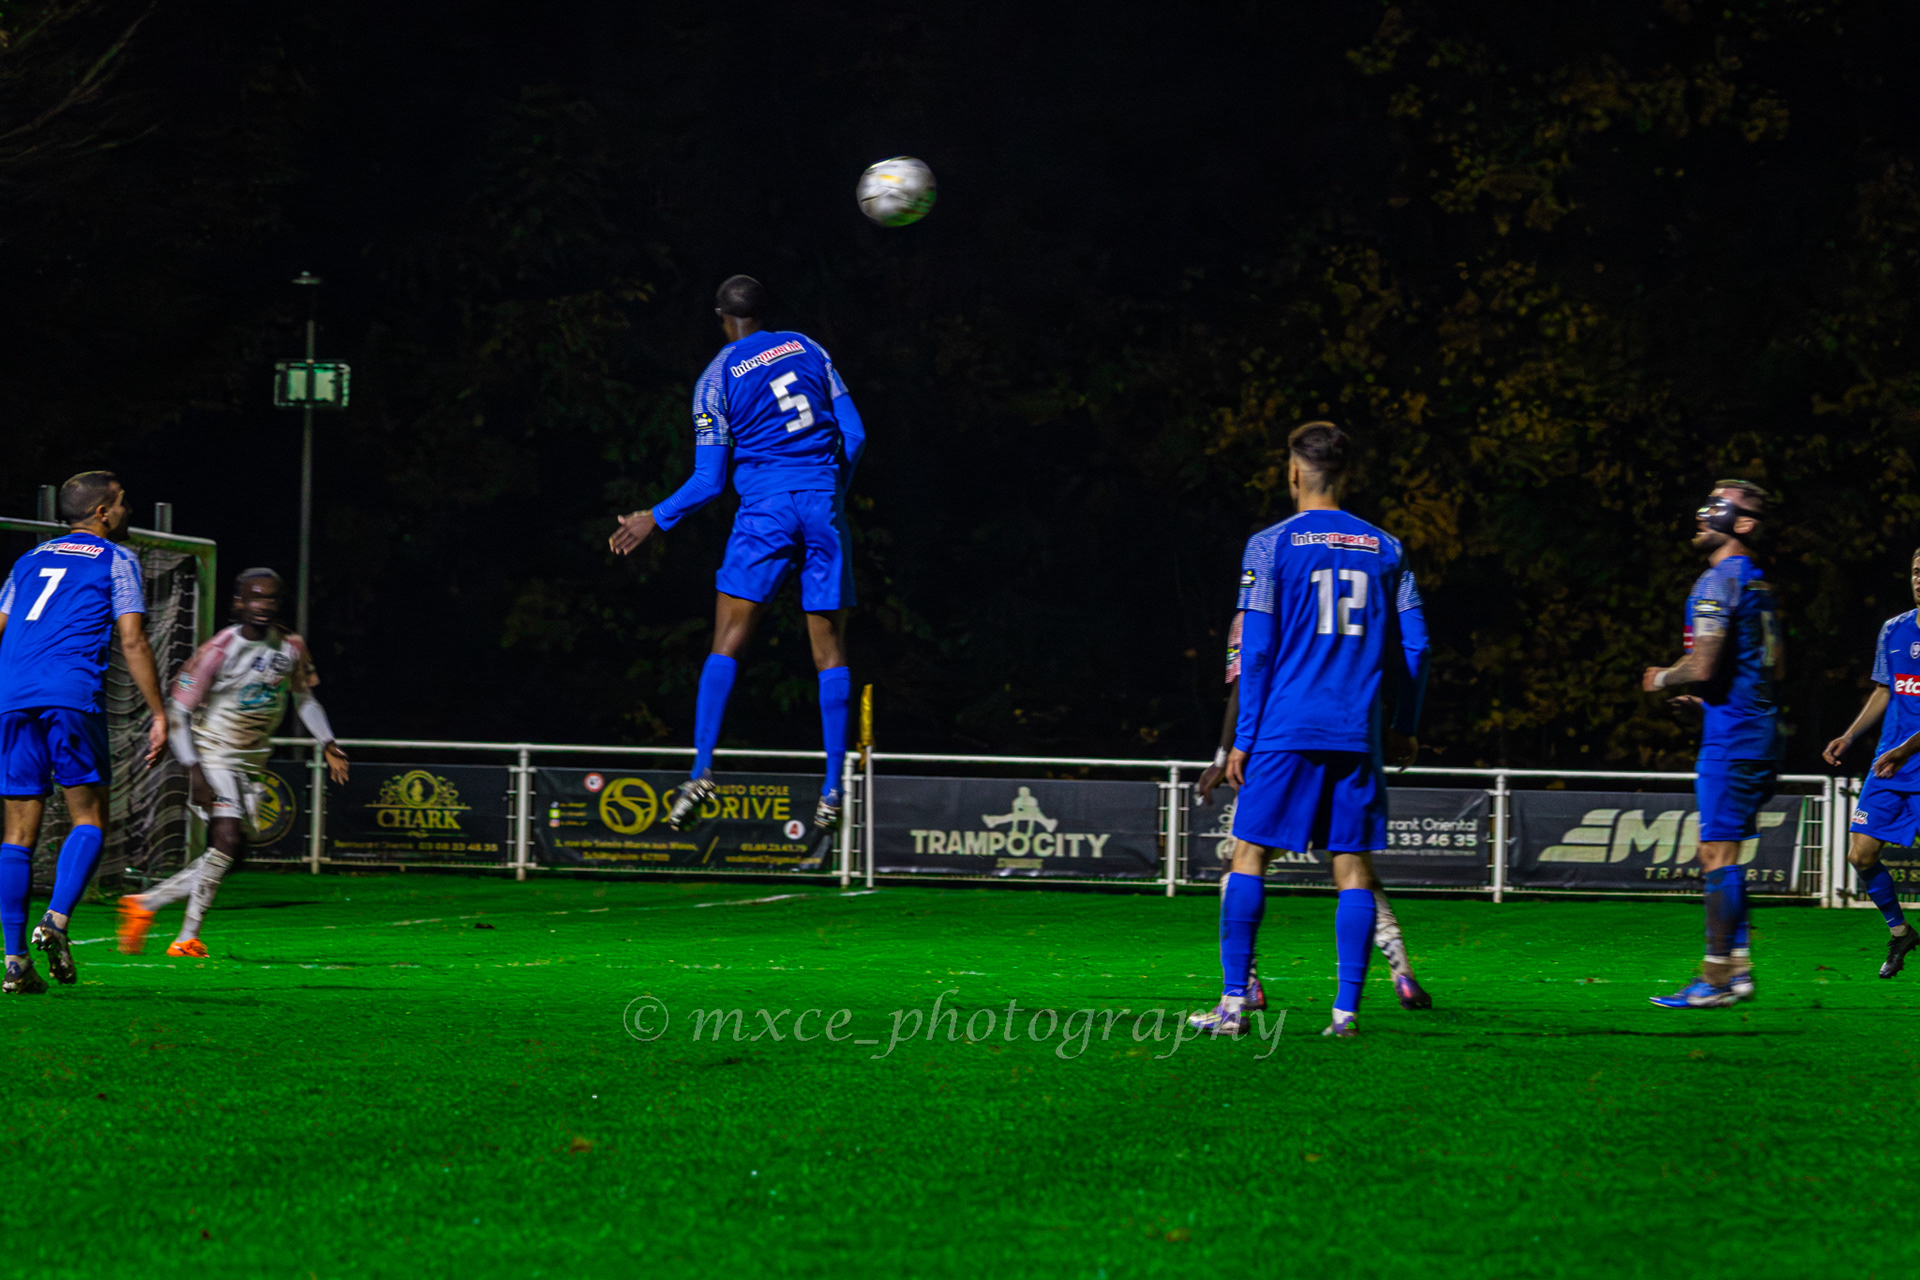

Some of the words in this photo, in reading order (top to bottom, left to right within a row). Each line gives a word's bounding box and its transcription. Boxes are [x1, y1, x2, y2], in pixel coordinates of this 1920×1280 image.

[769, 371, 815, 433] 5
[25, 568, 67, 620] 7
[1311, 568, 1368, 636] 12
[749, 785, 789, 796] ECOLE
[376, 809, 462, 829] CHARK
[1422, 818, 1478, 830] Oriental
[910, 830, 1110, 858] TRAMPOCITY
[1399, 833, 1422, 846] 33
[1425, 833, 1450, 846] 46
[1454, 834, 1478, 847] 35
